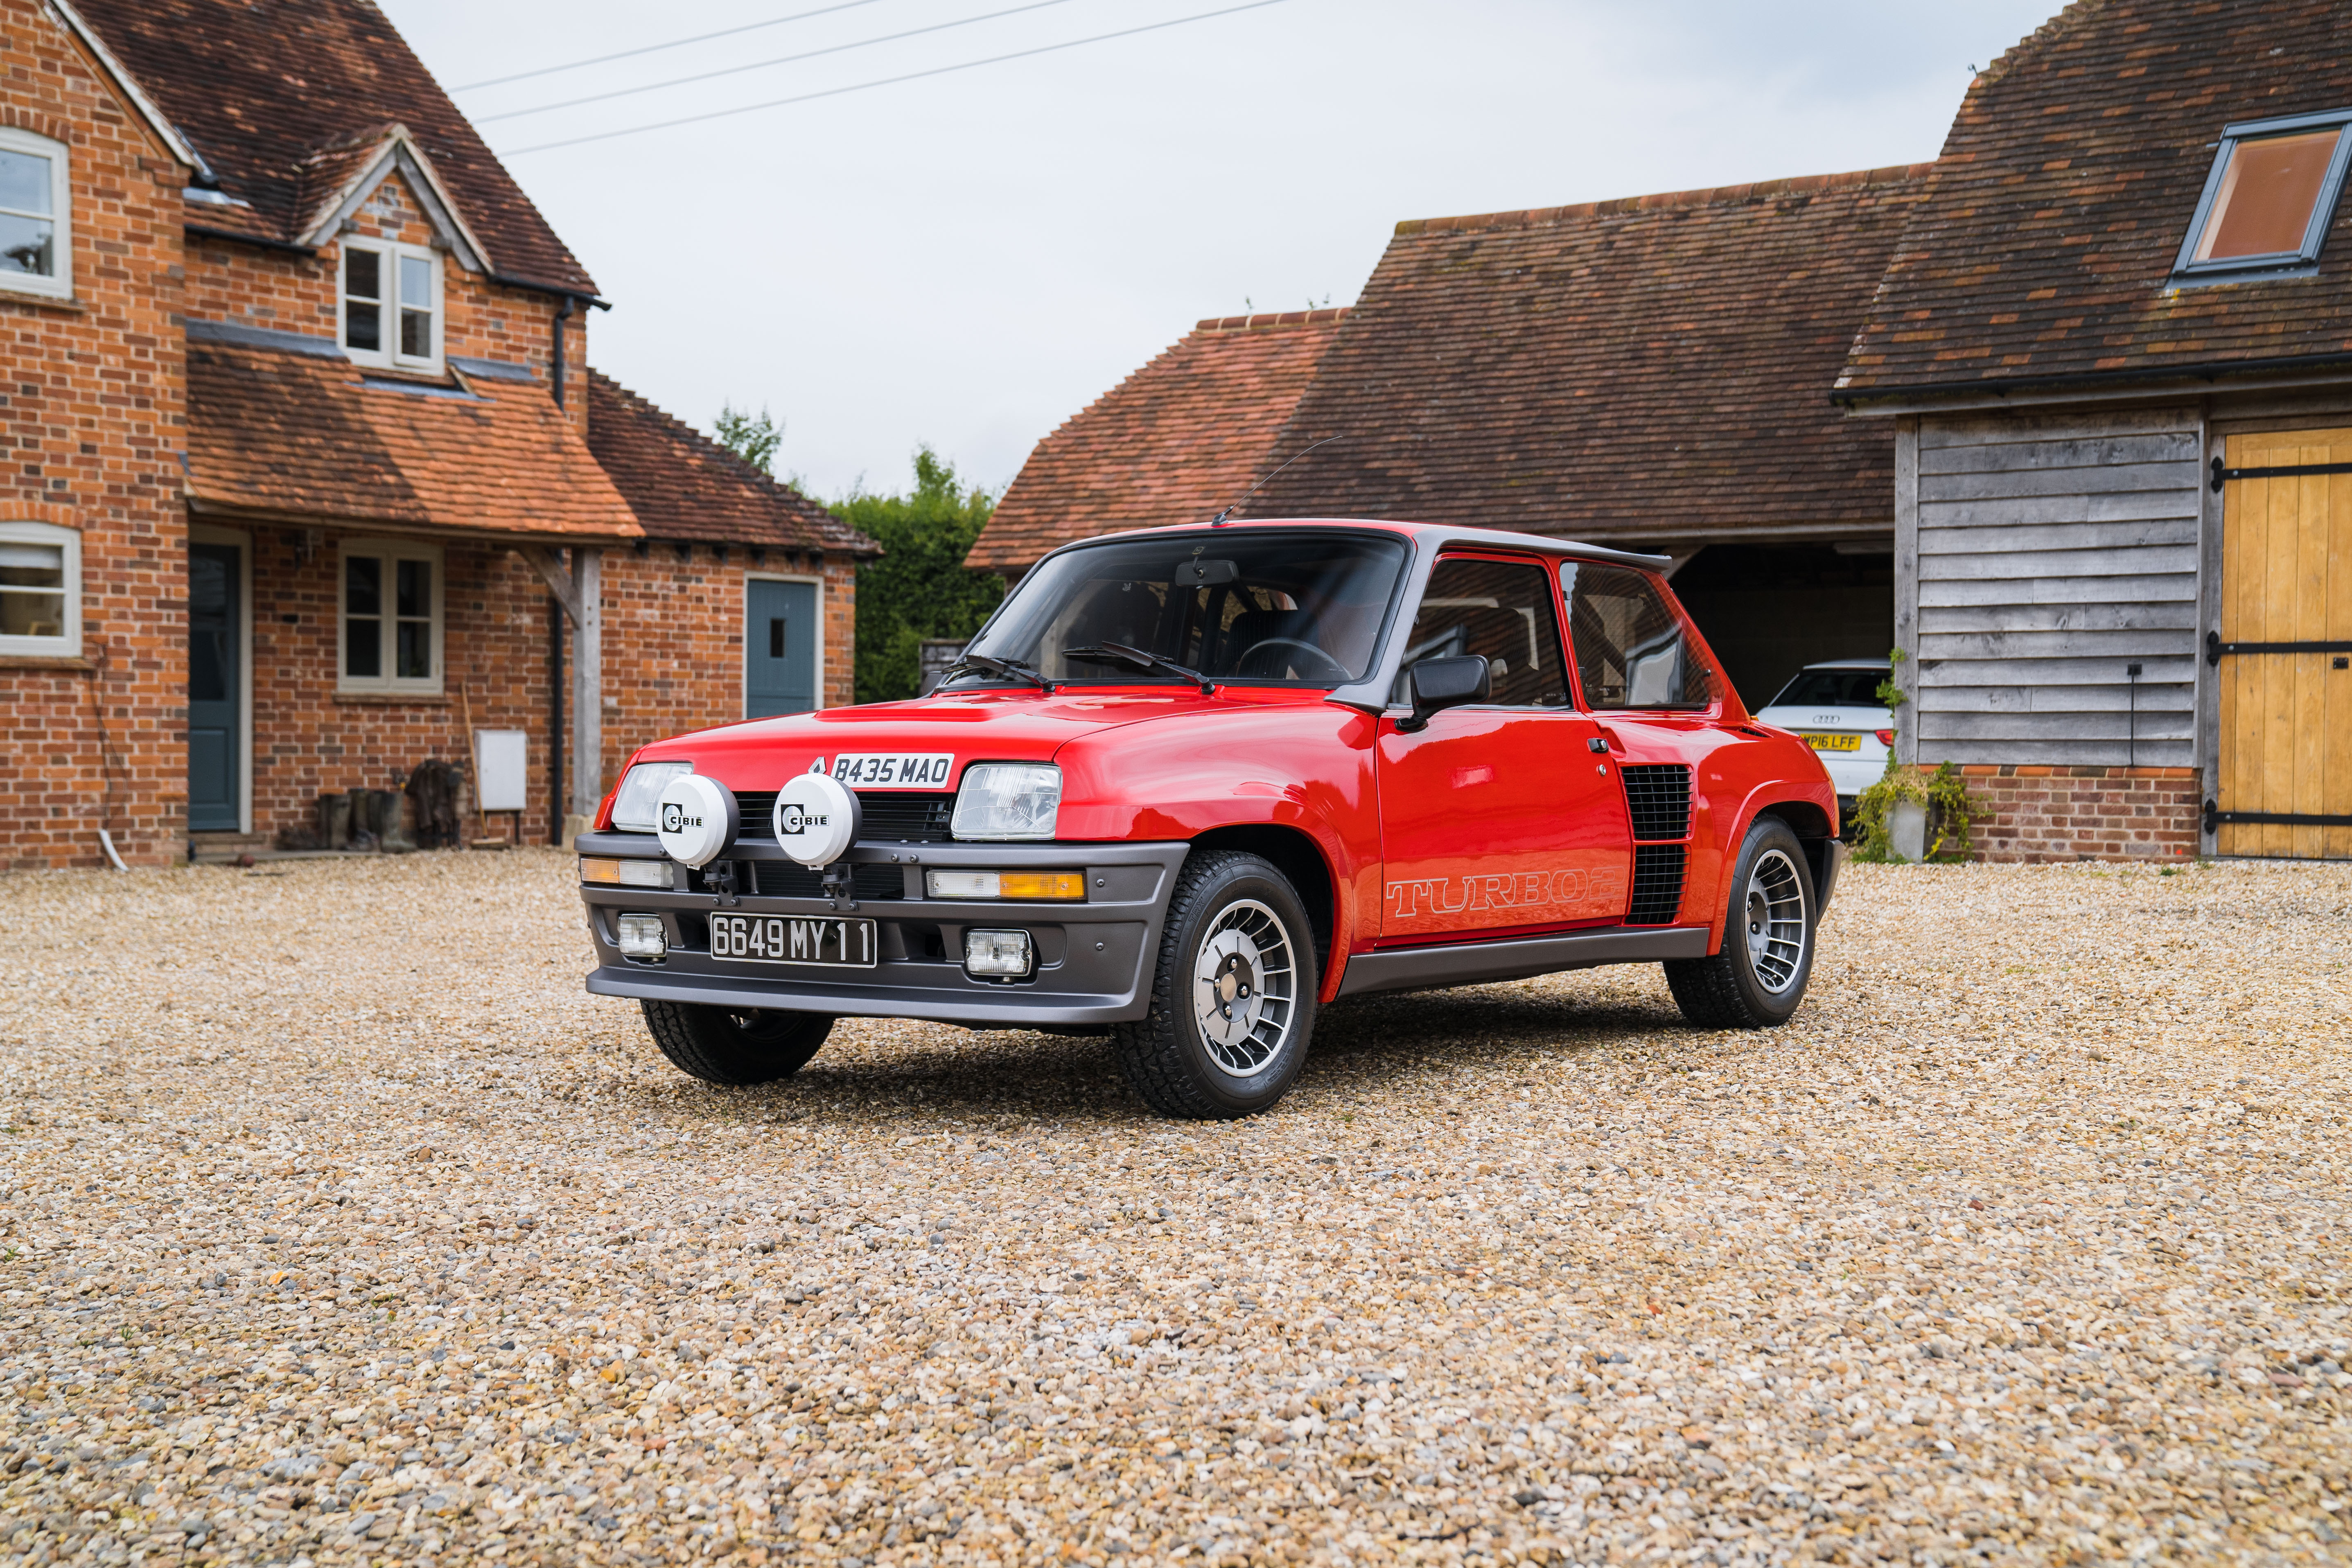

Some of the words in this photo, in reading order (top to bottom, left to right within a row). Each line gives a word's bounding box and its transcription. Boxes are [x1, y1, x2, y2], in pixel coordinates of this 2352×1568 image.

[1831, 736, 1856, 748] LFF
[835, 758, 897, 782] B435
[898, 758, 949, 783] MAO
[713, 917, 784, 957] 6649
[790, 920, 826, 959] MY
